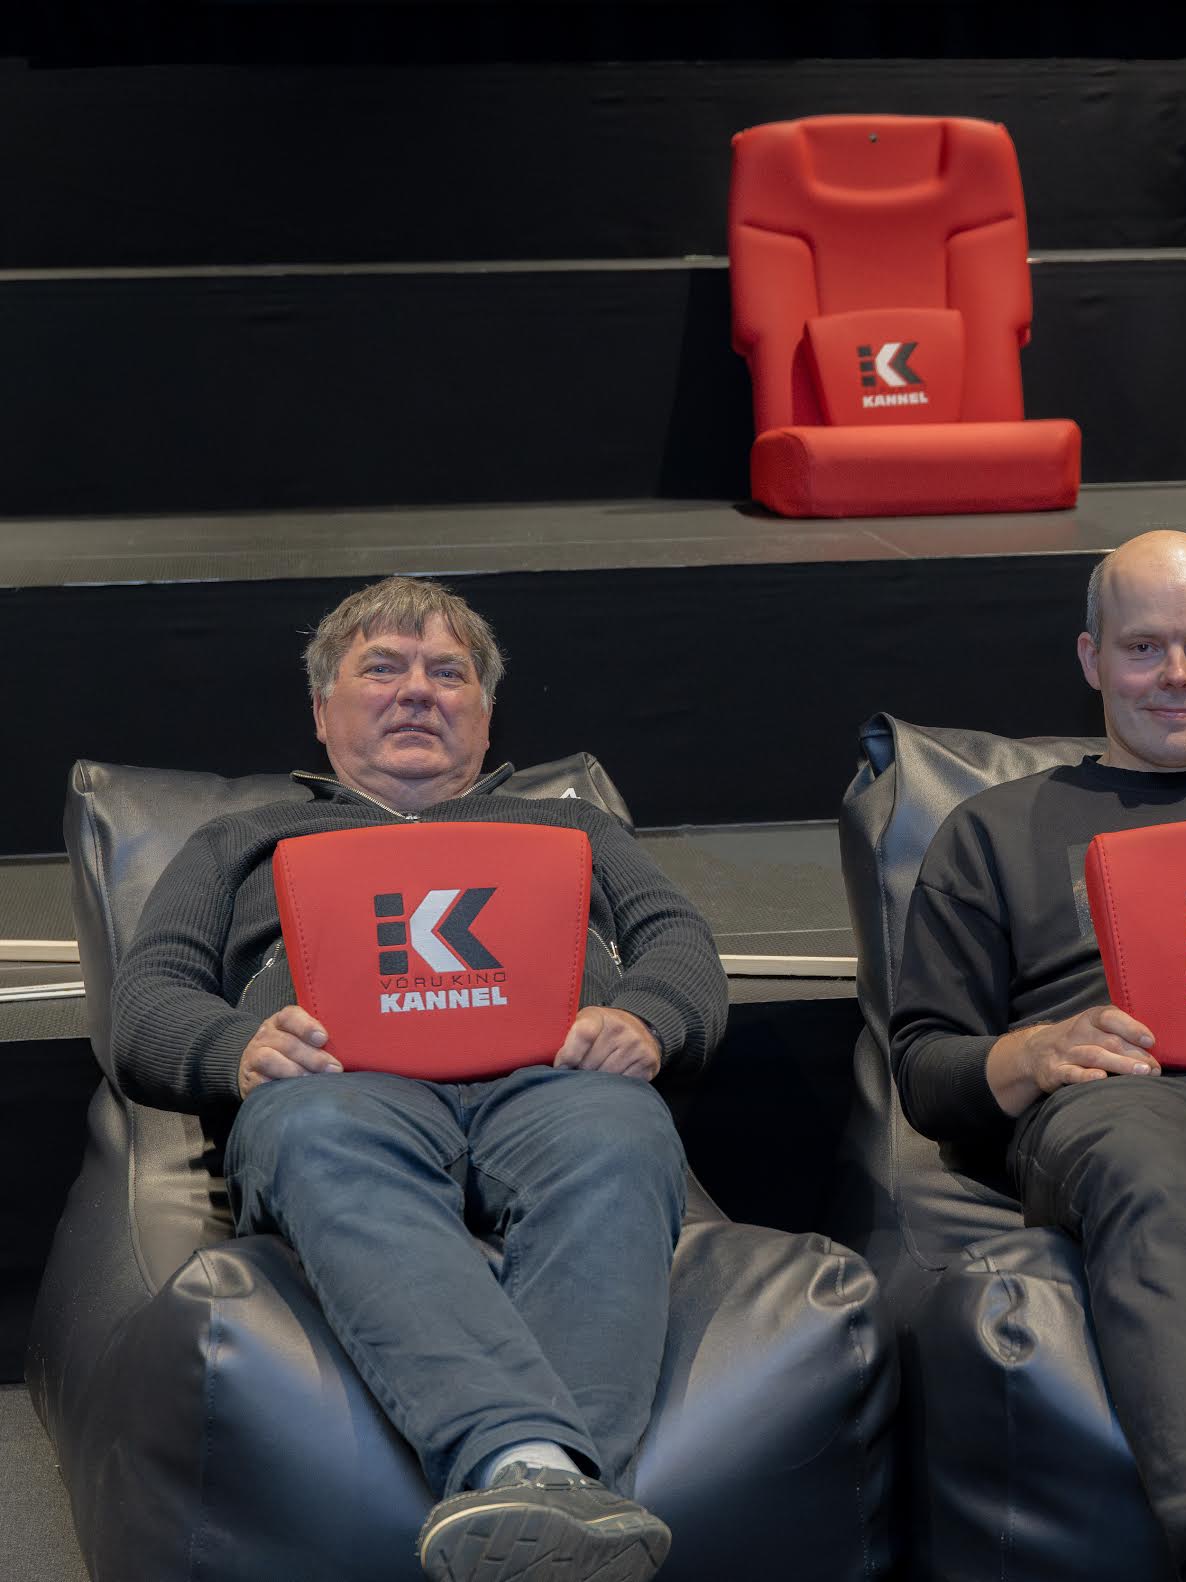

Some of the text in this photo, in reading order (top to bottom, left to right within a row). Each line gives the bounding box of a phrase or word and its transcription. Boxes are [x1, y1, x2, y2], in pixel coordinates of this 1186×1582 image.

[862, 391, 929, 409] KANNEL
[451, 972, 507, 986] KINO
[380, 986, 508, 1013] KANNEL
